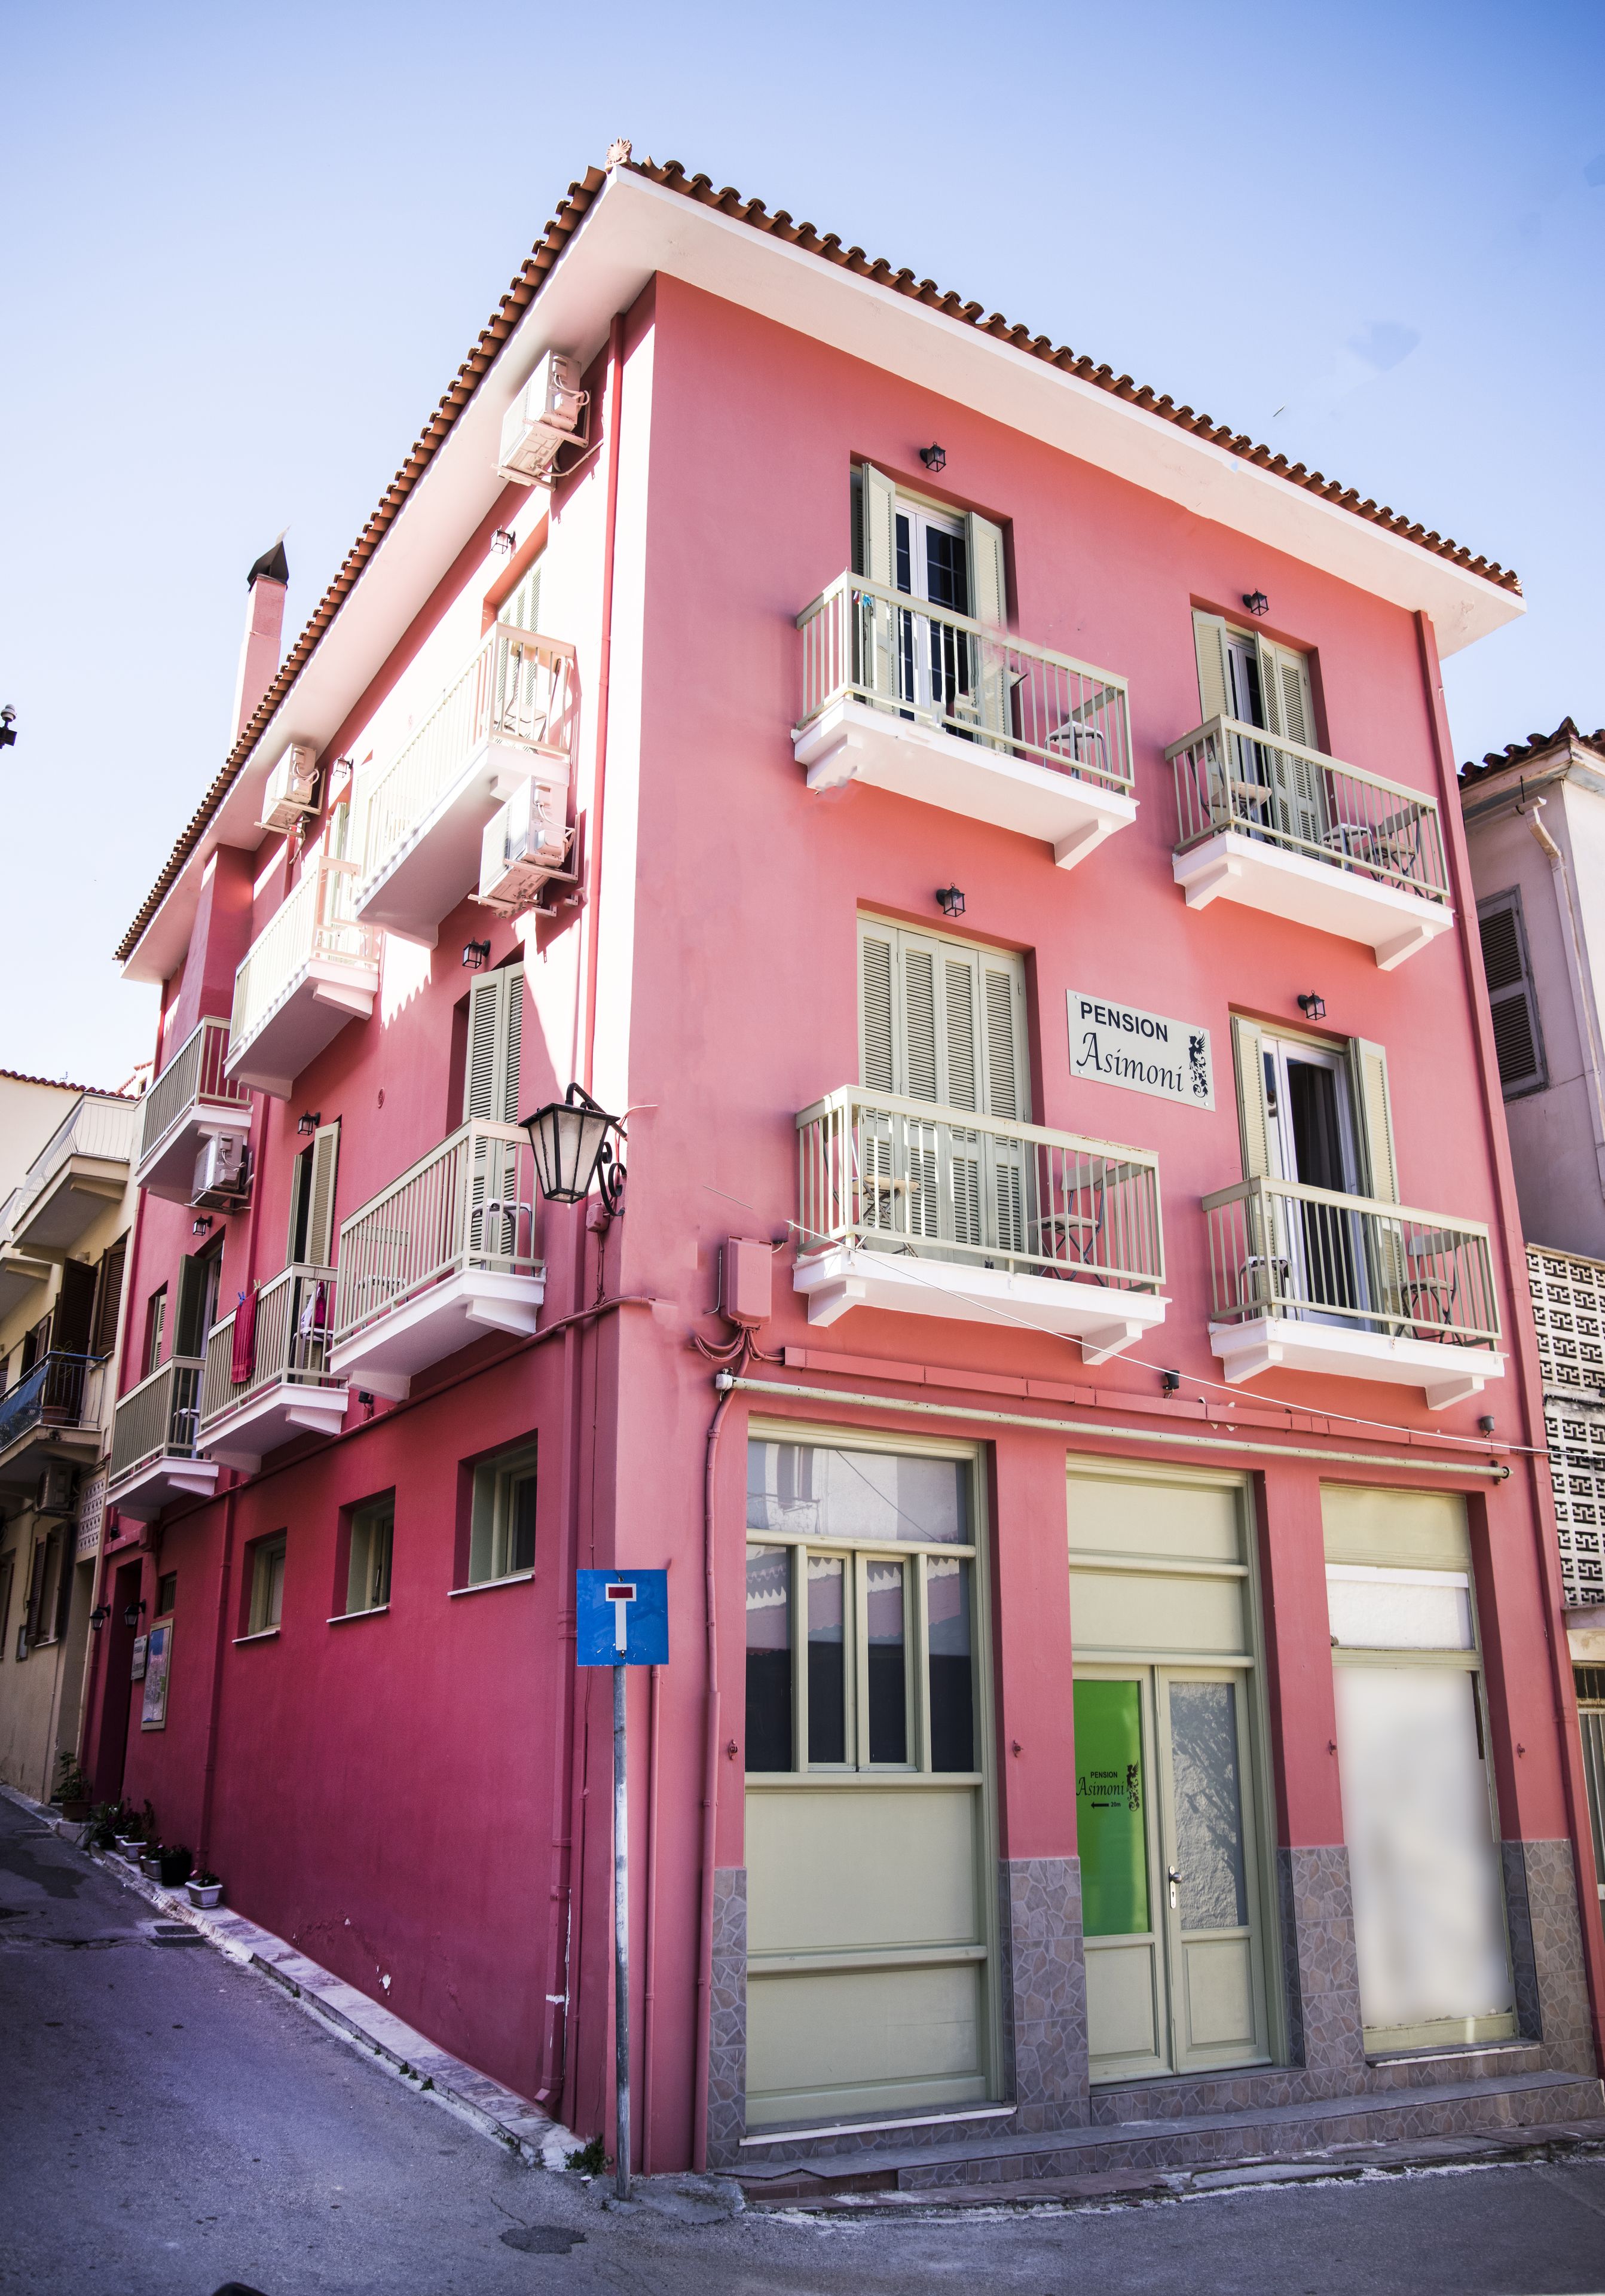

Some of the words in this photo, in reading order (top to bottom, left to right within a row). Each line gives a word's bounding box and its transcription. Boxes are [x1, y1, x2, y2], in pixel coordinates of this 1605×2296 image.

[1080, 1001, 1168, 1043] PENSION
[1075, 1032, 1184, 1092] Asimoni
[1075, 1776, 1124, 1796] Asimoni
